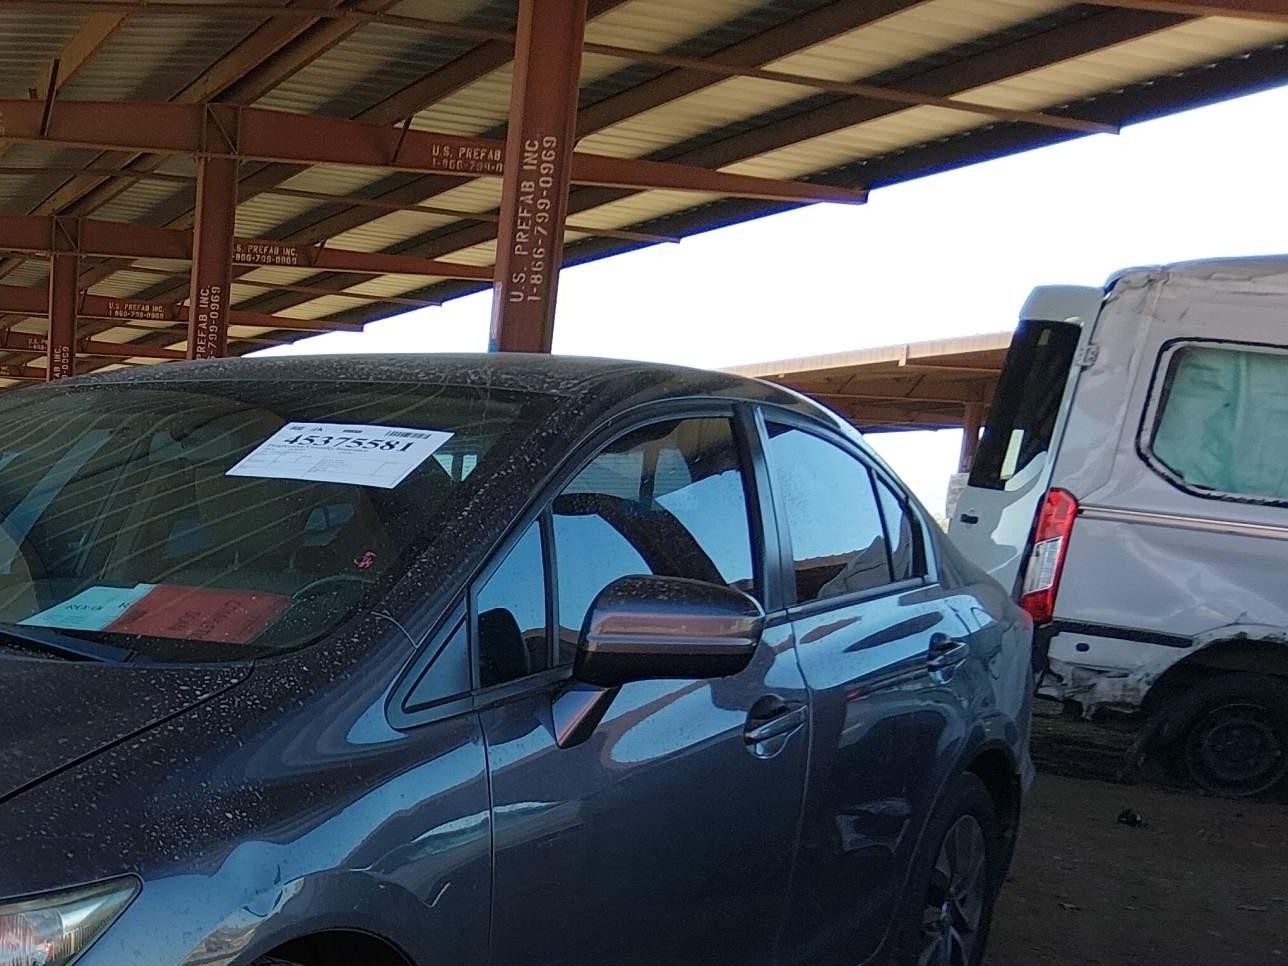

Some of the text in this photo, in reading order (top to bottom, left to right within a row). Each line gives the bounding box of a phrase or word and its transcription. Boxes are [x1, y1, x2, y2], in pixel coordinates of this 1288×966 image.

[432, 144, 502, 161] U.S. PREFAB
[515, 180, 536, 256] PREFAB
[527, 136, 557, 302] 1-866-799-0969
[248, 244, 280, 256] PREFAB
[509, 267, 528, 303] U.S.
[196, 285, 211, 360] PREFAB INC.
[283, 433, 416, 453] 45375581
